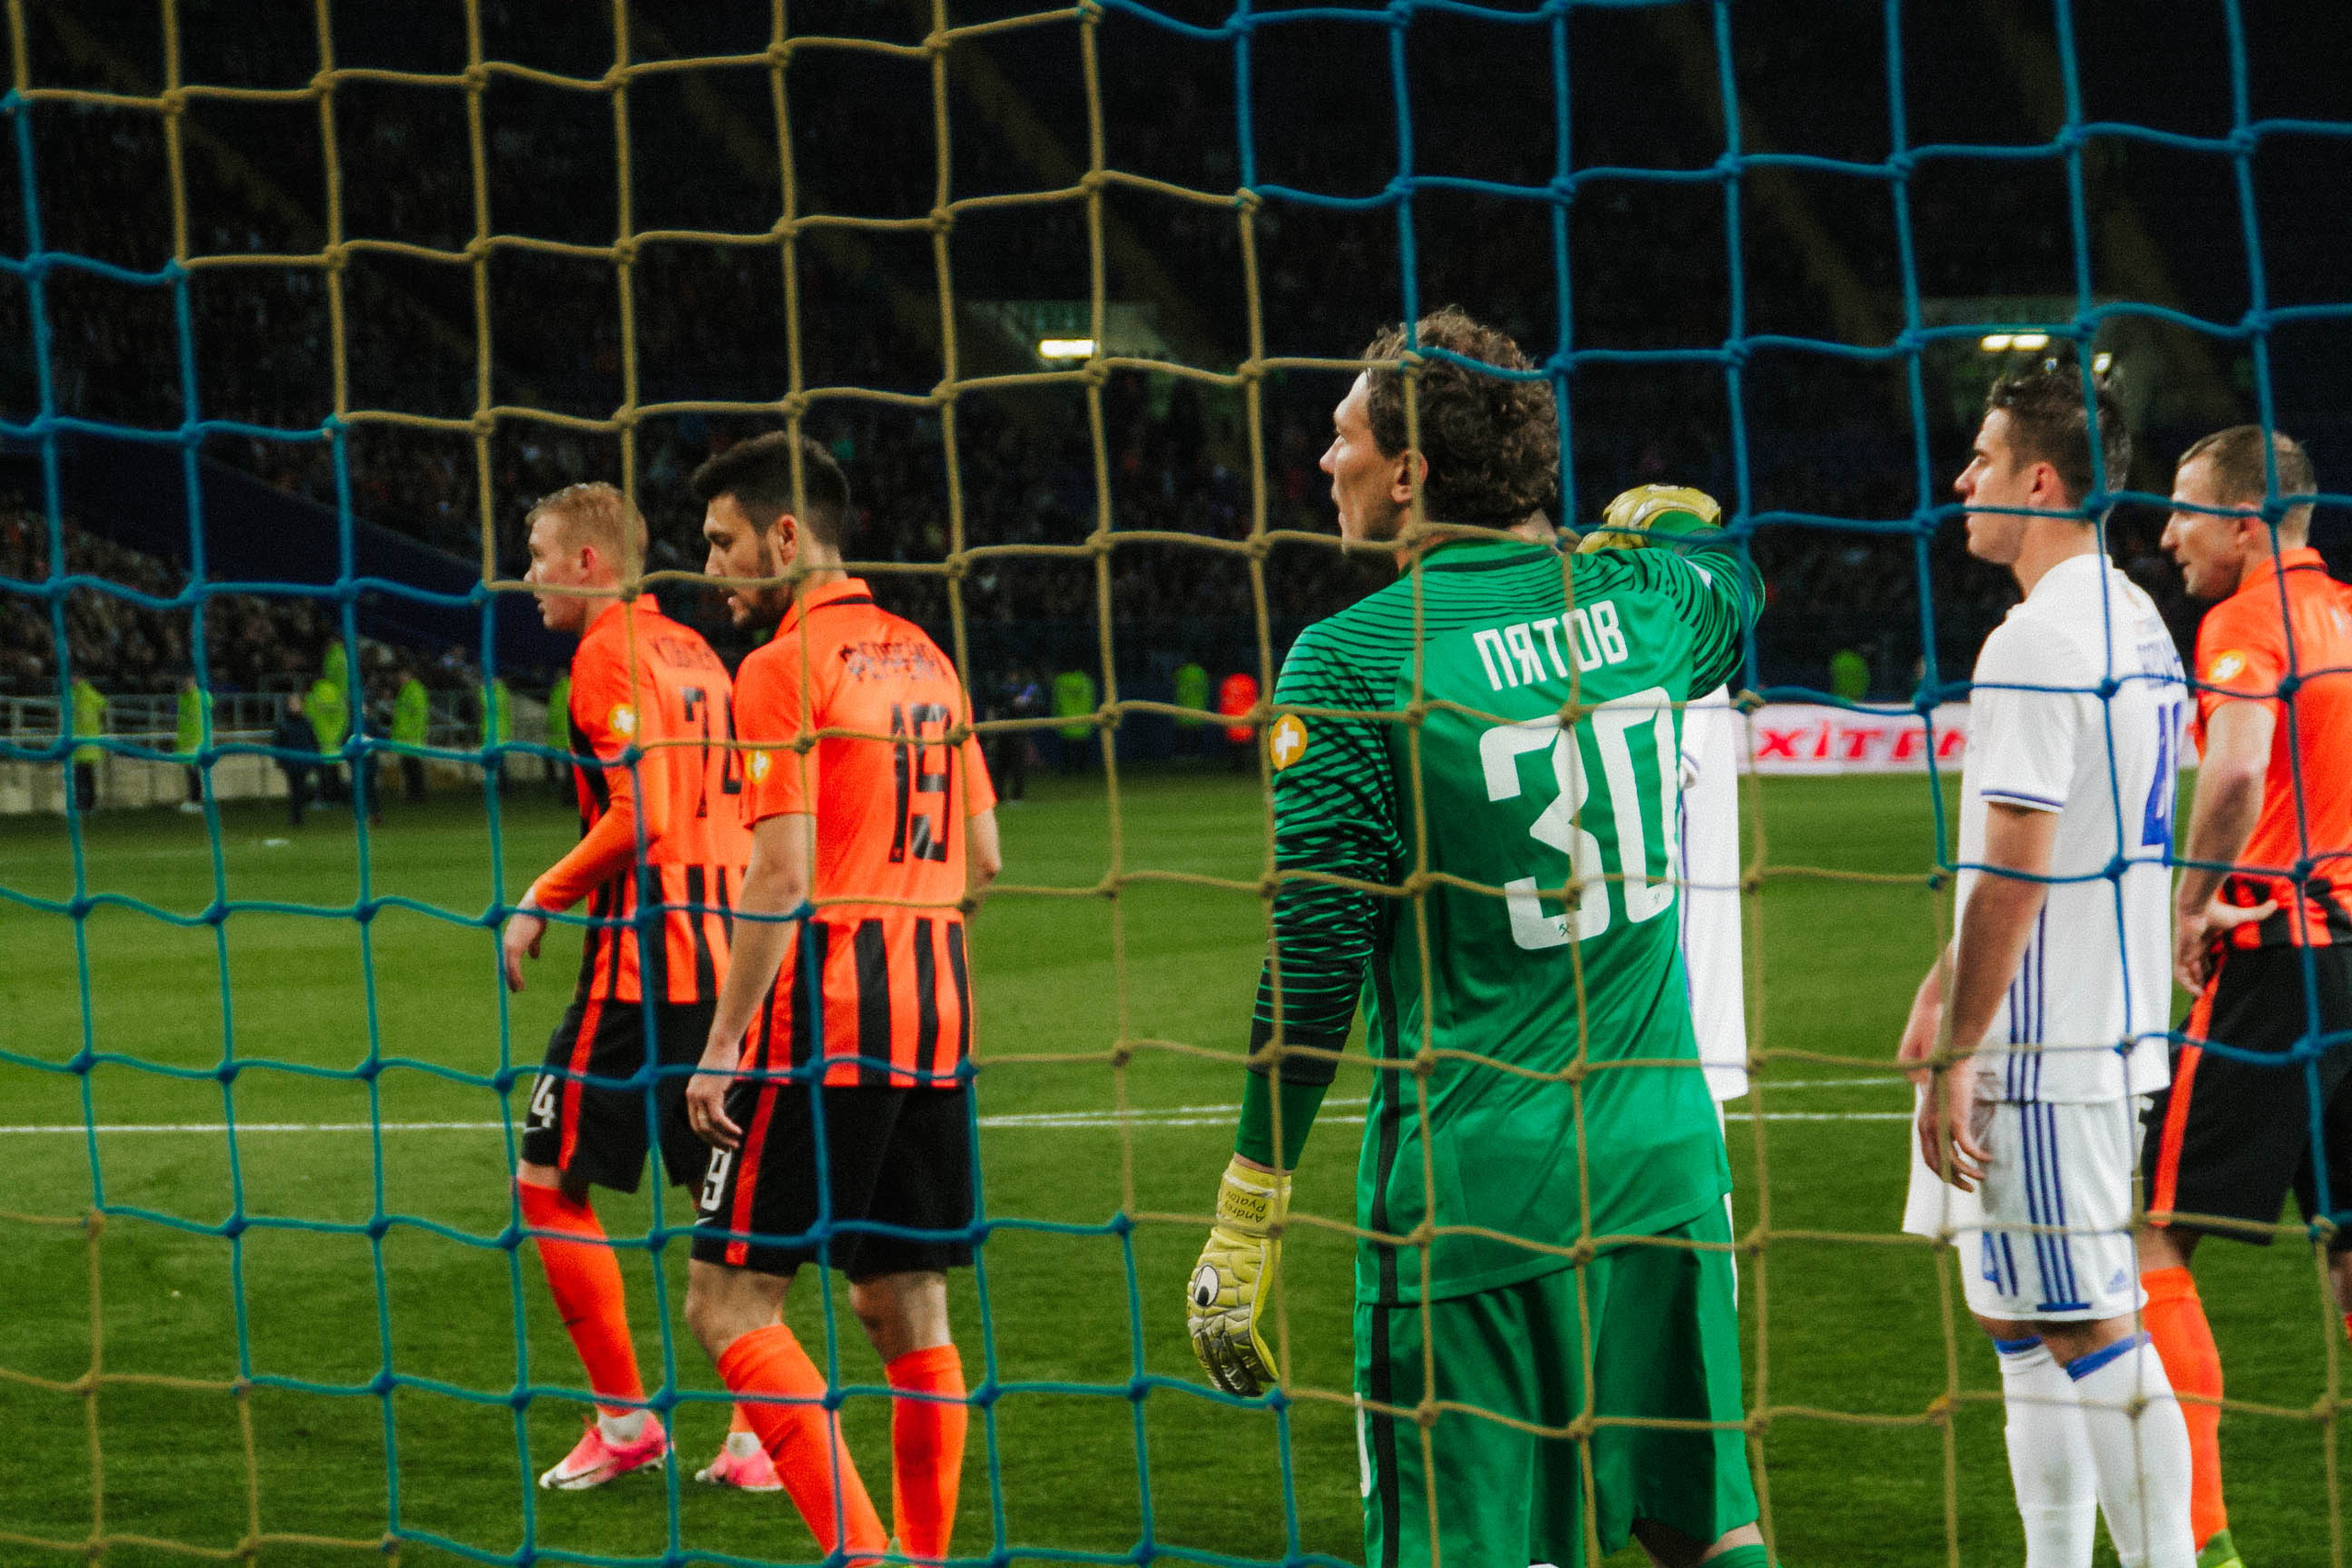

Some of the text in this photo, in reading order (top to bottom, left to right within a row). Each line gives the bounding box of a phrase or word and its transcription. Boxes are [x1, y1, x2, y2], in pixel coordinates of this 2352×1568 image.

[1473, 600, 1629, 692] ПЯТОВ
[888, 702, 952, 863] 19
[1479, 686, 1676, 950] 30
[529, 1073, 556, 1129] 4
[1225, 1200, 1266, 1224] Andrey
